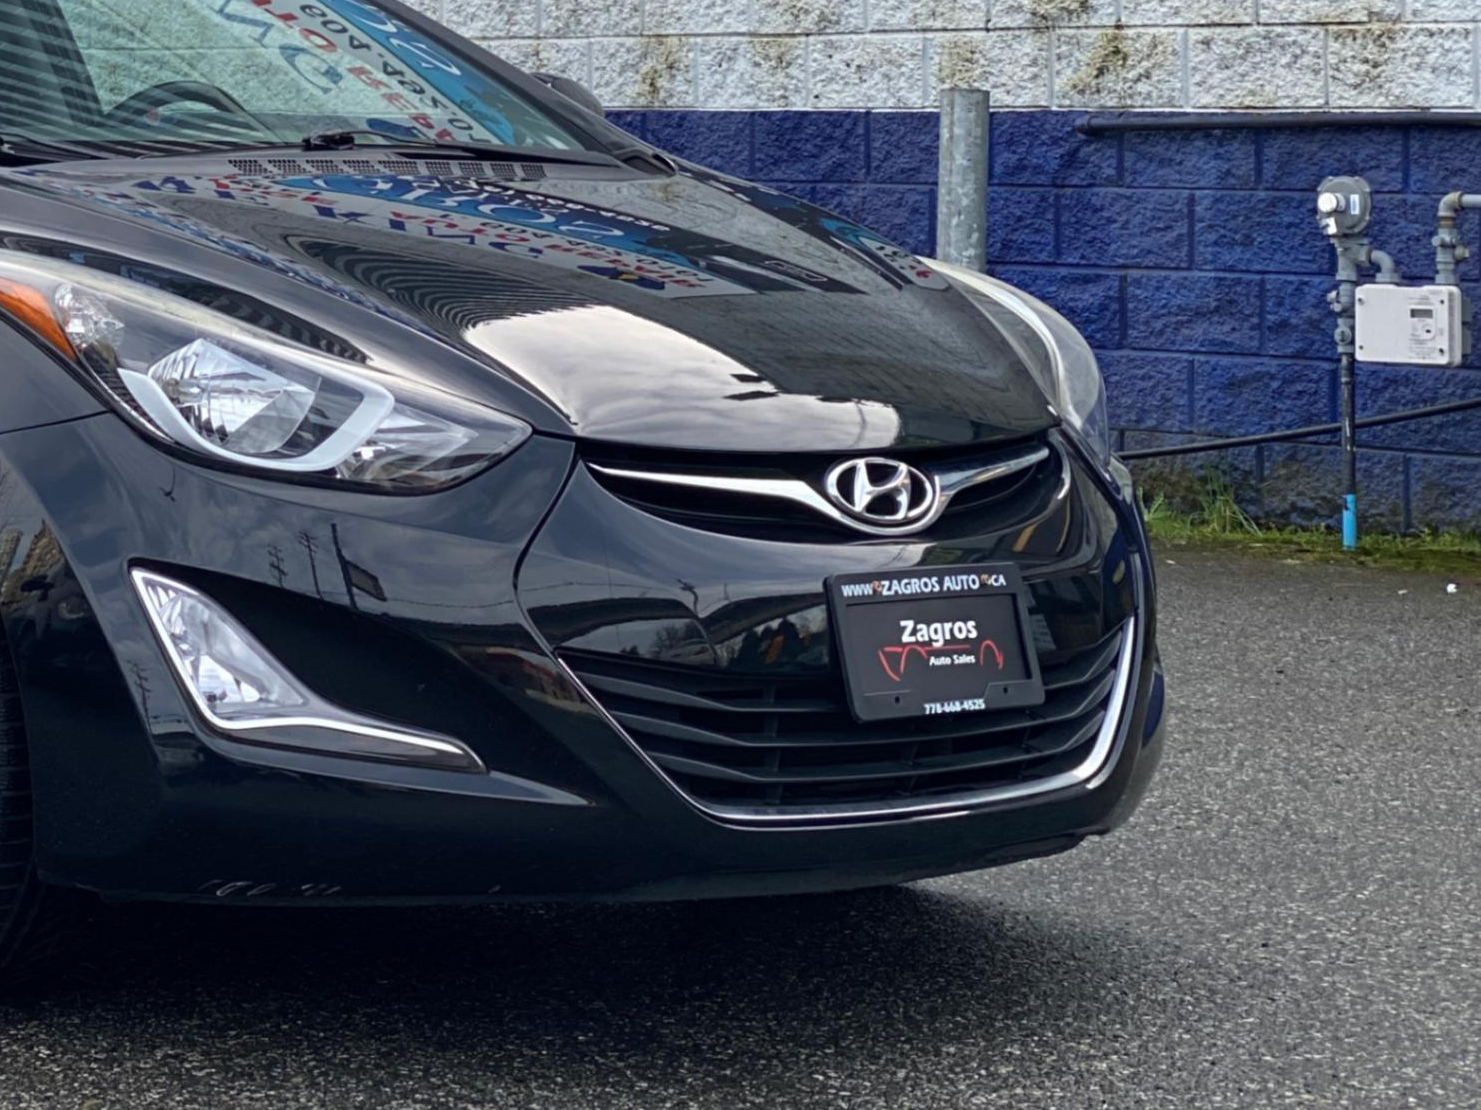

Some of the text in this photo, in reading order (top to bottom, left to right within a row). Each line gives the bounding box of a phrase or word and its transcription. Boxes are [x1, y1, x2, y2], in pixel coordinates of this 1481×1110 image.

[900, 619, 978, 647] Zagros
[929, 654, 976, 666] Auto Sales
[923, 698, 986, 715] 778-668-4525
